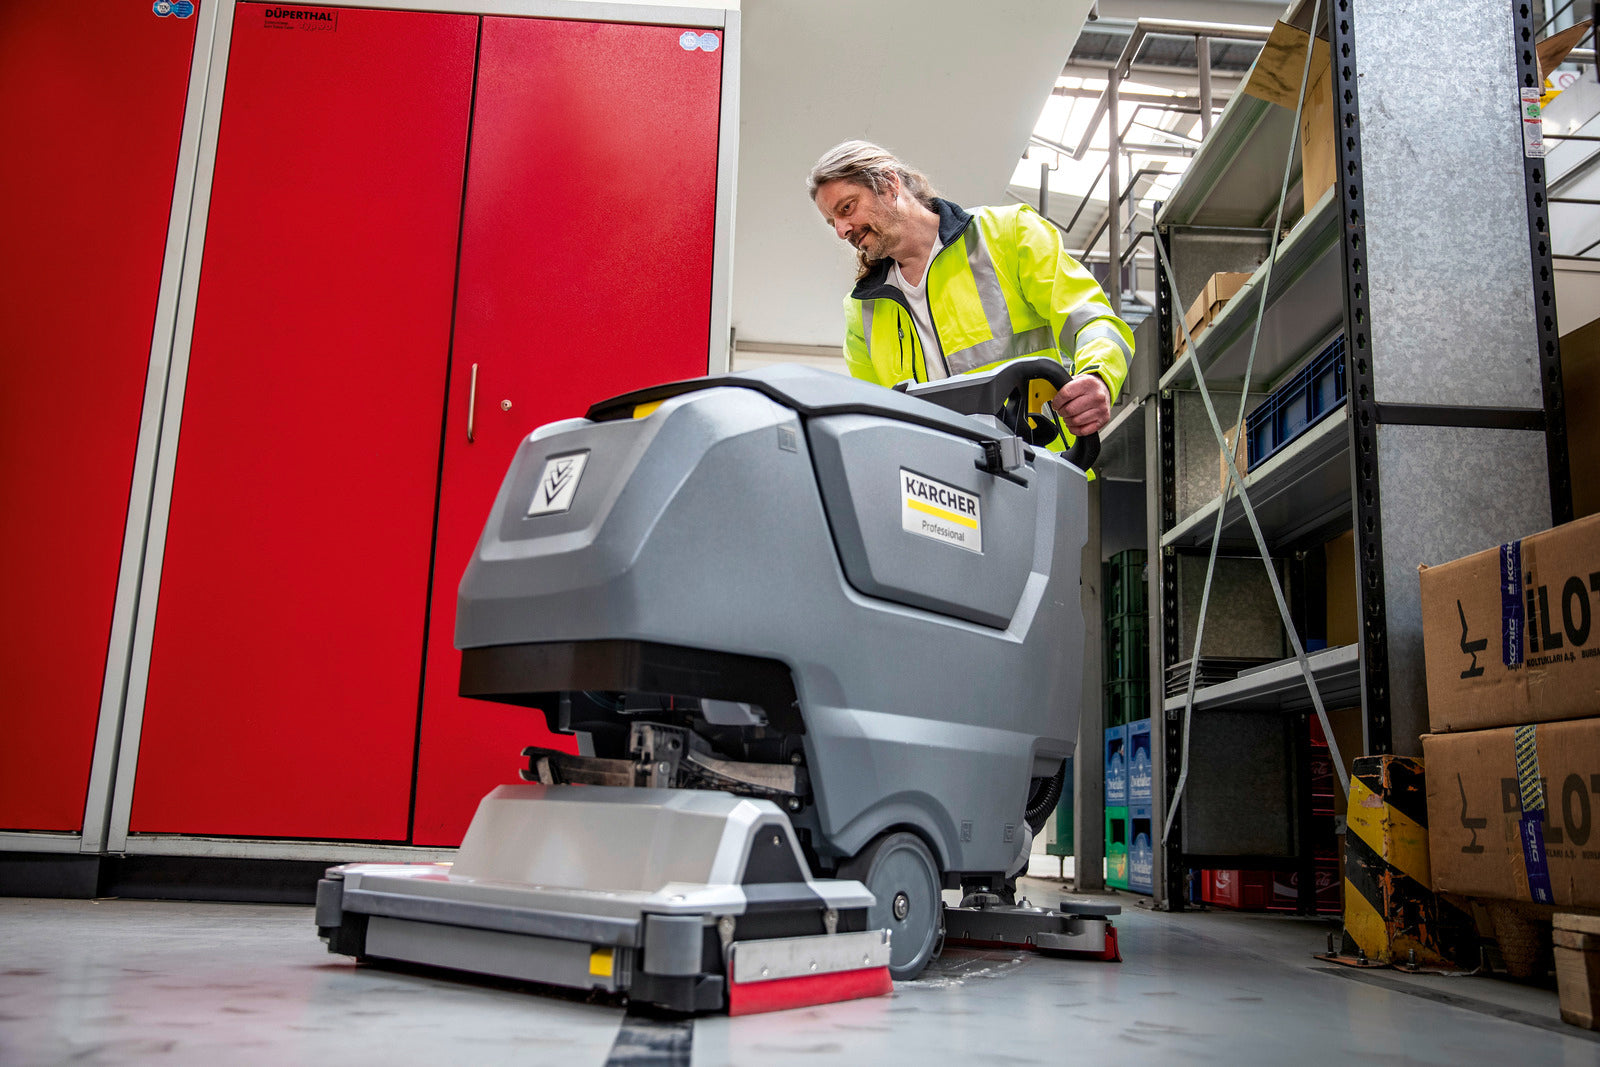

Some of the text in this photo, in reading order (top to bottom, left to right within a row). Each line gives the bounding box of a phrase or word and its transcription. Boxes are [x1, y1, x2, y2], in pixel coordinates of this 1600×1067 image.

[265, 7, 333, 21] DÜPERTHAL
[906, 477, 976, 516] KÄRCHER
[922, 520, 965, 542] Professional
